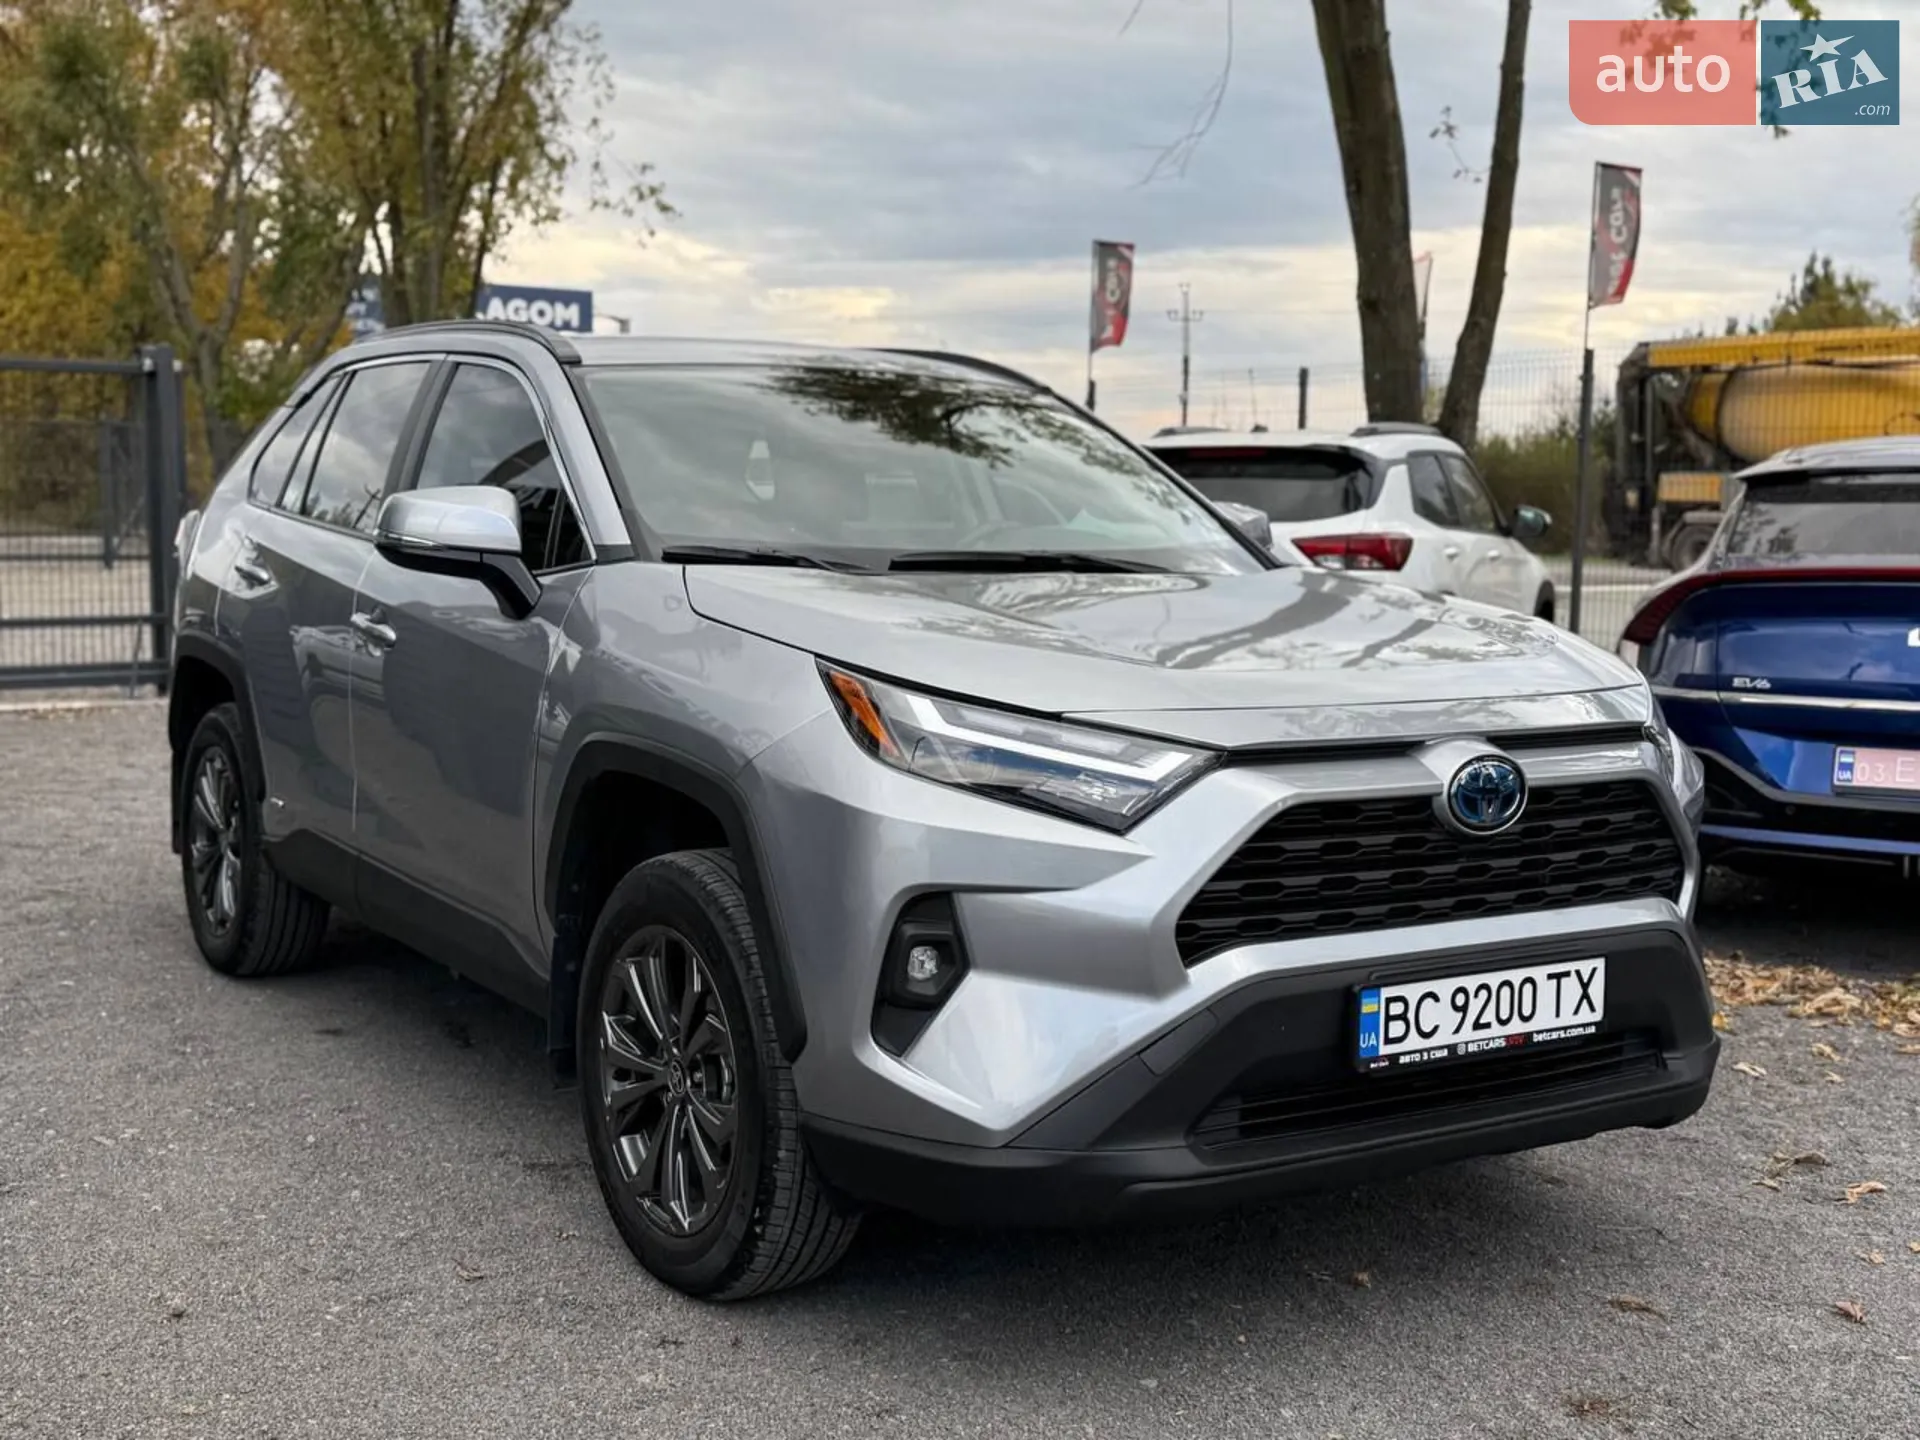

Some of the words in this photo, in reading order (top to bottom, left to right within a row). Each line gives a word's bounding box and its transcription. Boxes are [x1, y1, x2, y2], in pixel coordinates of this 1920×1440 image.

[475, 297, 580, 328] AGOM
[1732, 677, 1771, 689] EV6
[1838, 769, 1852, 781] UA
[1856, 763, 1885, 782] 03
[1383, 991, 1441, 1045] BC
[1450, 976, 1537, 1035] 9200
[1547, 967, 1598, 1018] TX
[1360, 1031, 1377, 1048] UA
[1533, 1025, 1596, 1042] betcars.com.ua
